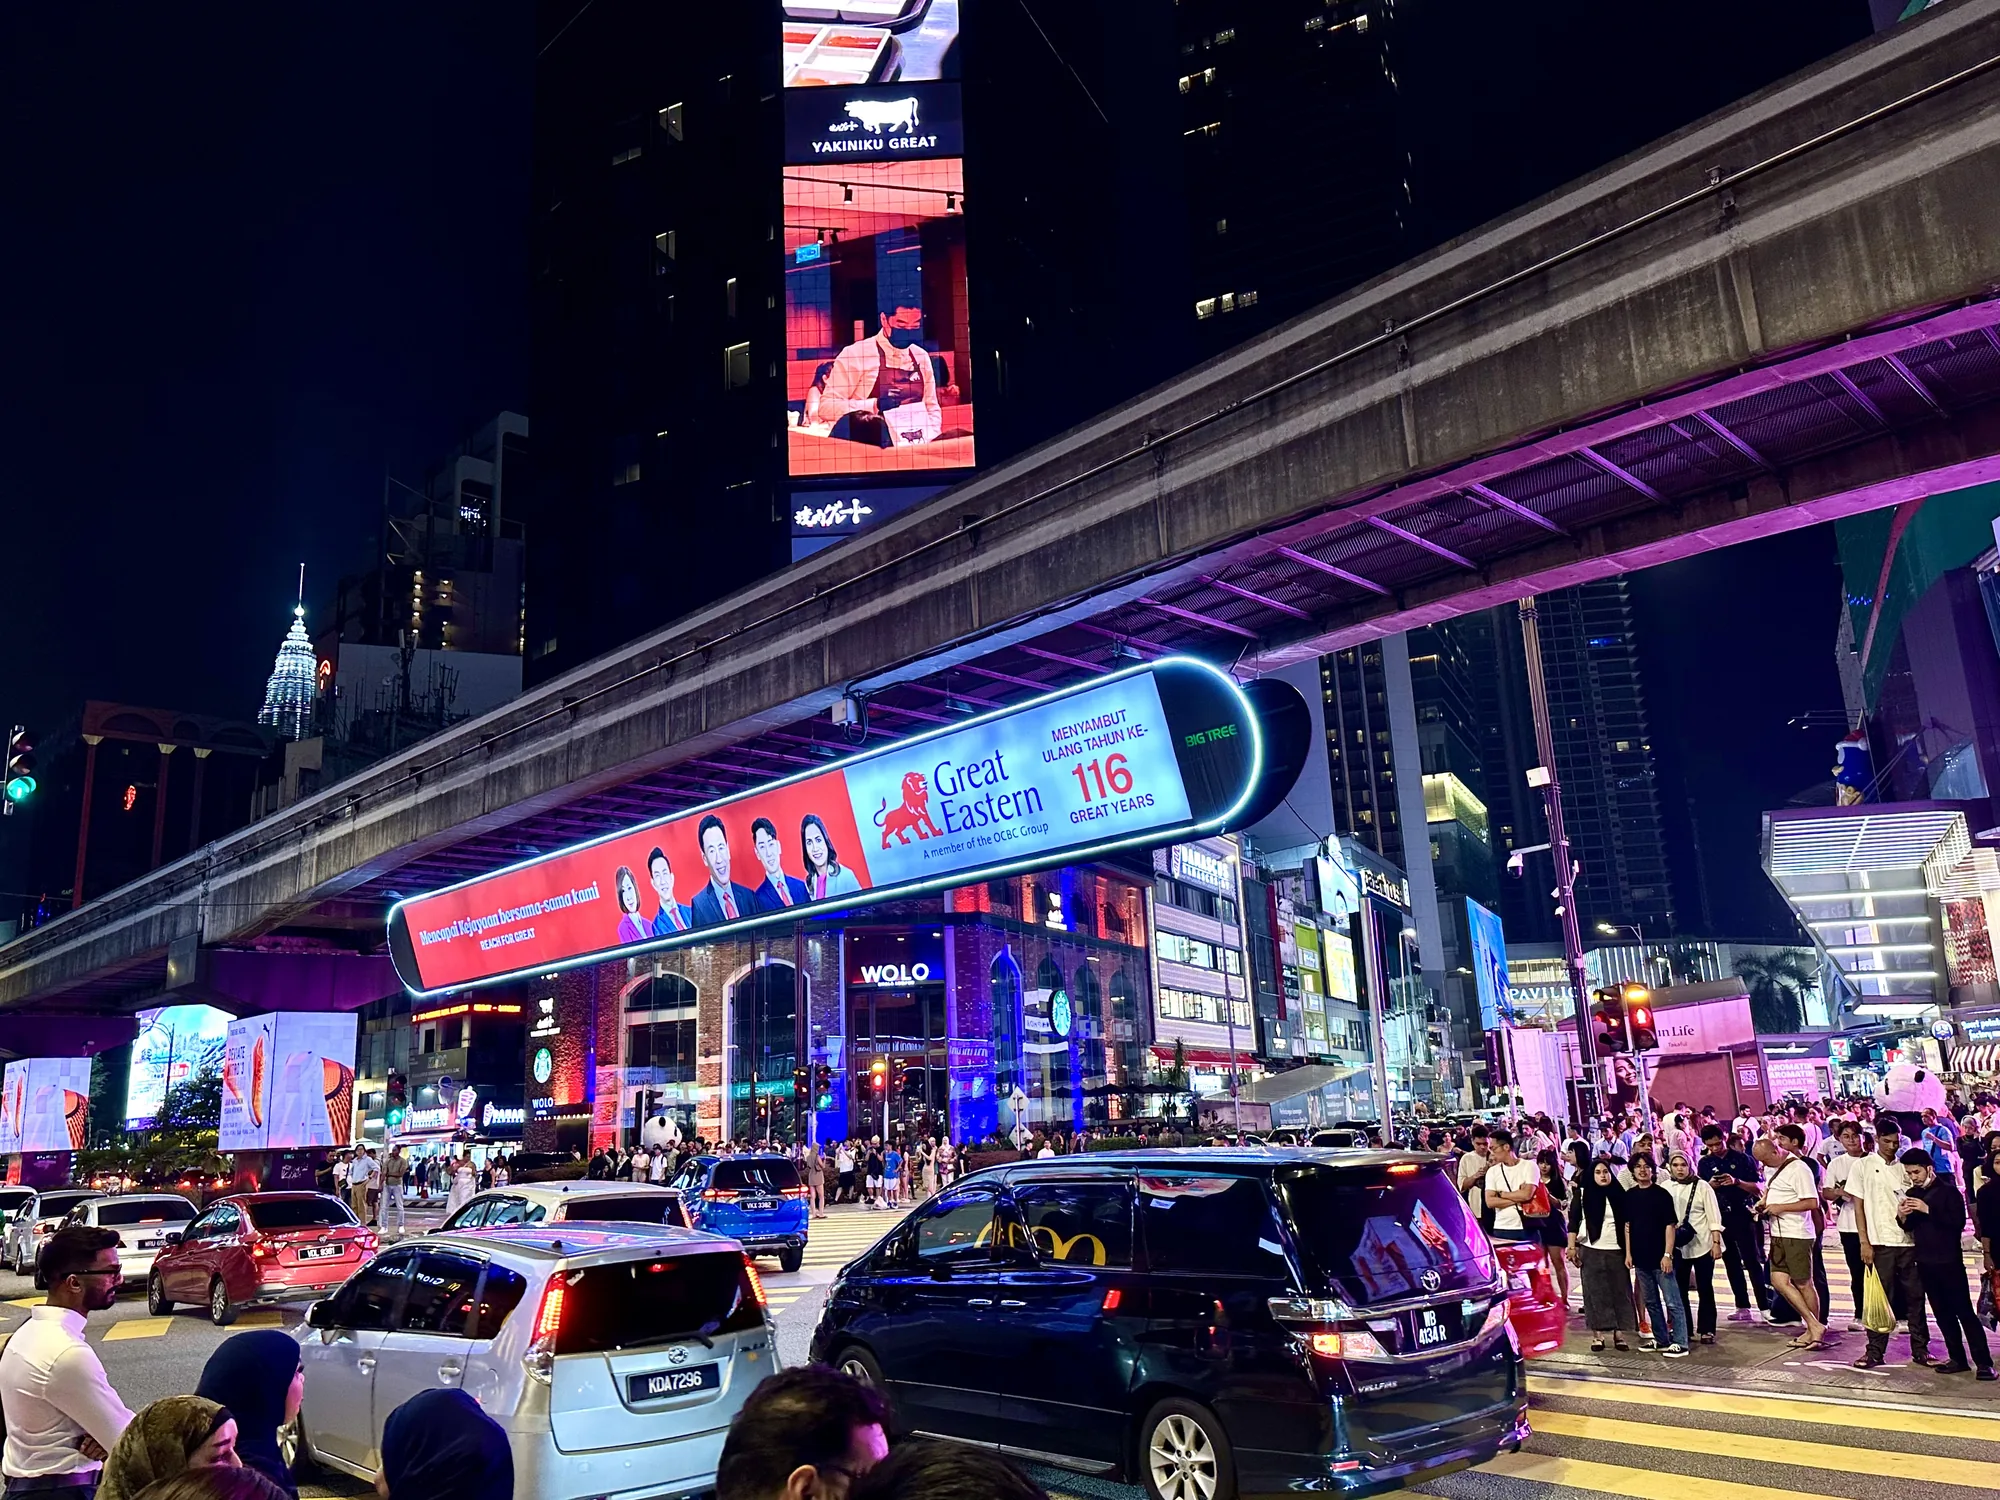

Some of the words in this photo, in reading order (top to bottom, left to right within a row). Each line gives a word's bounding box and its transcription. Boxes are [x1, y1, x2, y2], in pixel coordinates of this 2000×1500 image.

[812, 138, 883, 153] YAKINIKU
[889, 136, 937, 149] GREAT
[1051, 709, 1127, 742] MENYAMBUT
[1185, 733, 1206, 747] BIG
[1206, 724, 1238, 742] TREE
[1042, 742, 1083, 763] ULANG
[1084, 731, 1125, 752] TAHUN
[1126, 724, 1149, 739] KE-
[934, 749, 1009, 797] Great
[1071, 753, 1133, 803] 116
[940, 786, 1043, 834] Eastern
[1070, 804, 1109, 824] GREAT
[1111, 793, 1155, 812] YEARS
[923, 850, 930, 859] A
[931, 843, 964, 858] member
[967, 838, 976, 850] of
[977, 834, 993, 846] the
[993, 828, 1017, 843] OCBC
[1020, 822, 1049, 837] Group
[419, 920, 459, 945] Mencapai
[458, 914, 500, 938] Kejayaan
[498, 895, 572, 924] bersama-sama
[571, 880, 600, 904] kami
[480, 934, 501, 950] REACH
[500, 931, 514, 946] FOR
[515, 928, 536, 943] GREAT
[861, 963, 929, 983] WOLO
[1672, 1025, 1695, 1037] Life
[1767, 1063, 1812, 1071] AROMATIK
[1768, 1070, 1814, 1078] AROMATIK
[532, 1097, 553, 1109] WOLO
[1424, 1311, 1437, 1326] WB
[1419, 1326, 1439, 1345] 4134
[648, 1371, 702, 1394] KDA7296
